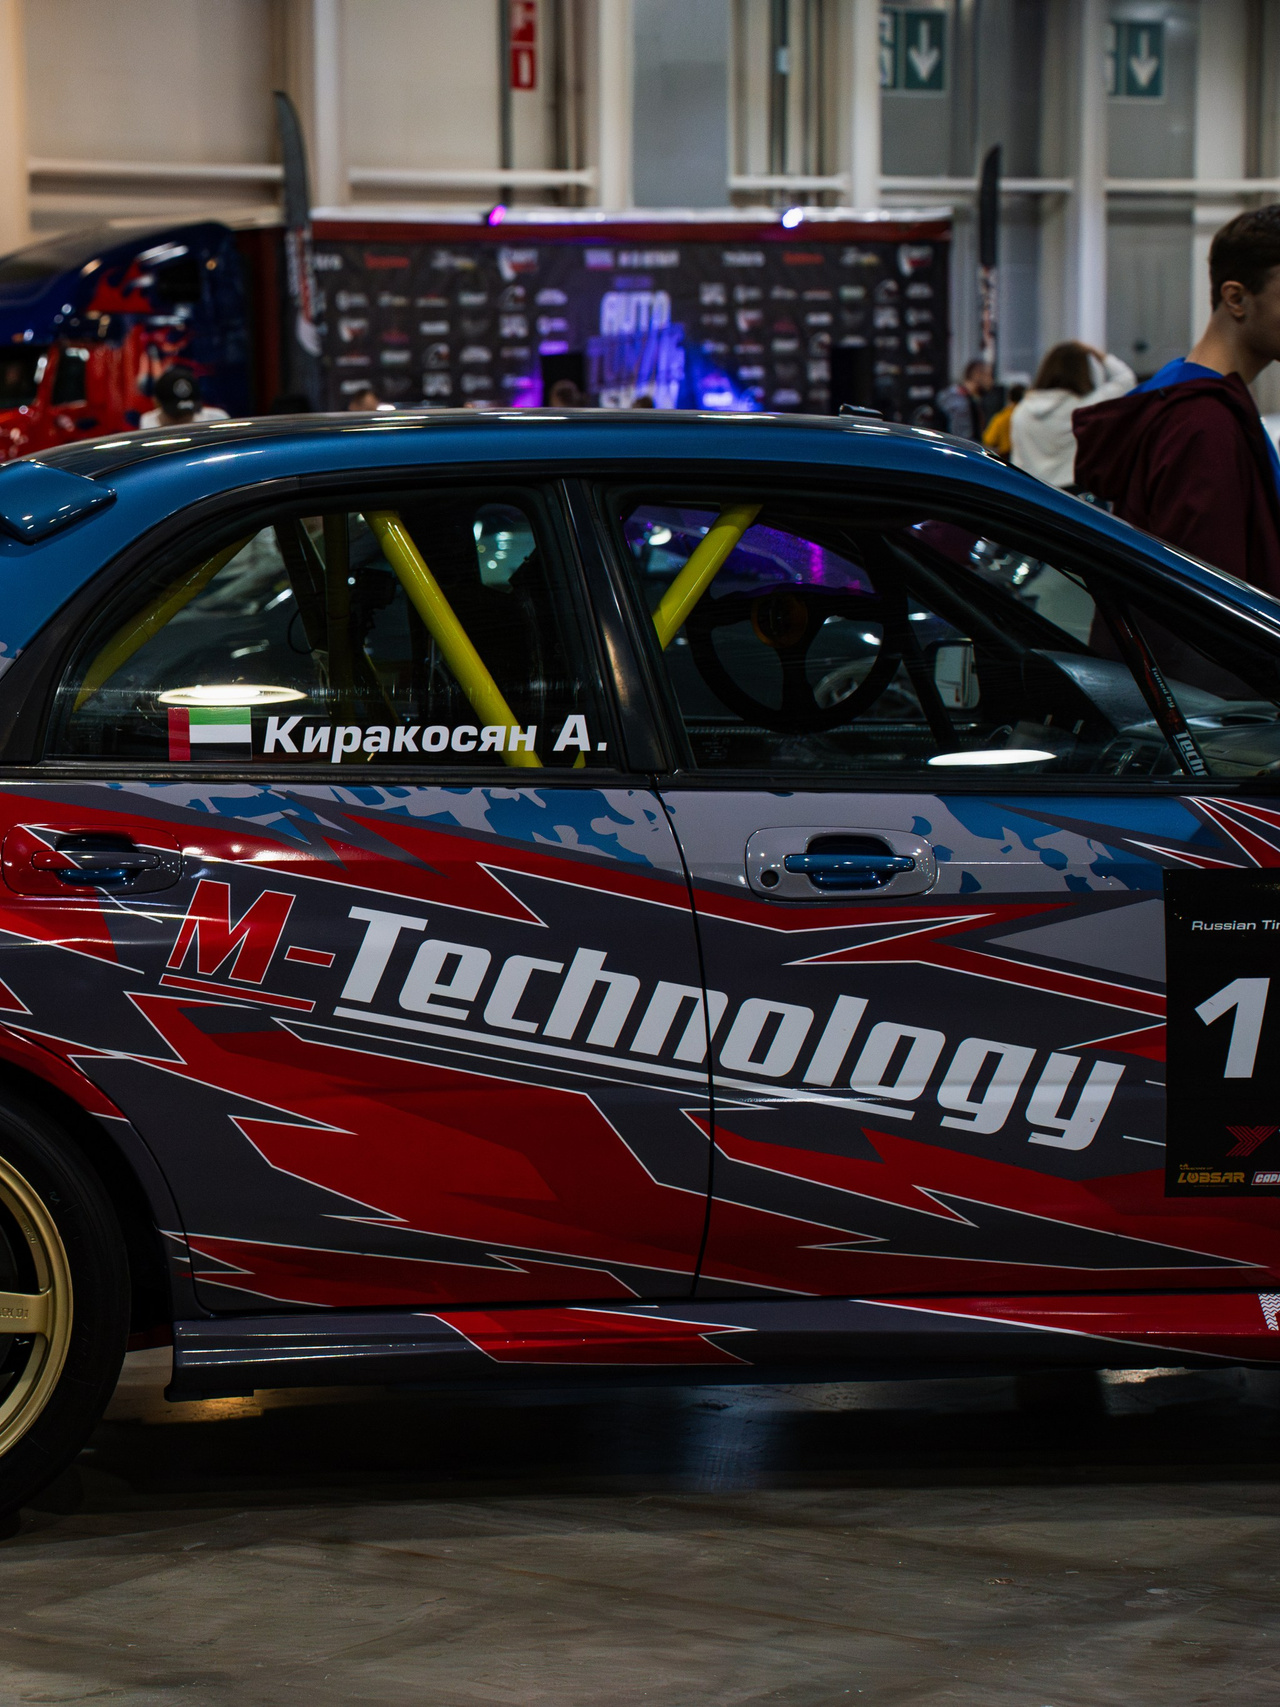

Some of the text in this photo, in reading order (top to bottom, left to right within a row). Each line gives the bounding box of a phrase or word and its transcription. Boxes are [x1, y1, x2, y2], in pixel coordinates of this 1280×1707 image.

[263, 714, 608, 763] Киракосян А.
[1191, 920, 1257, 931] Russian
[166, 879, 1125, 1151] M-Technology
